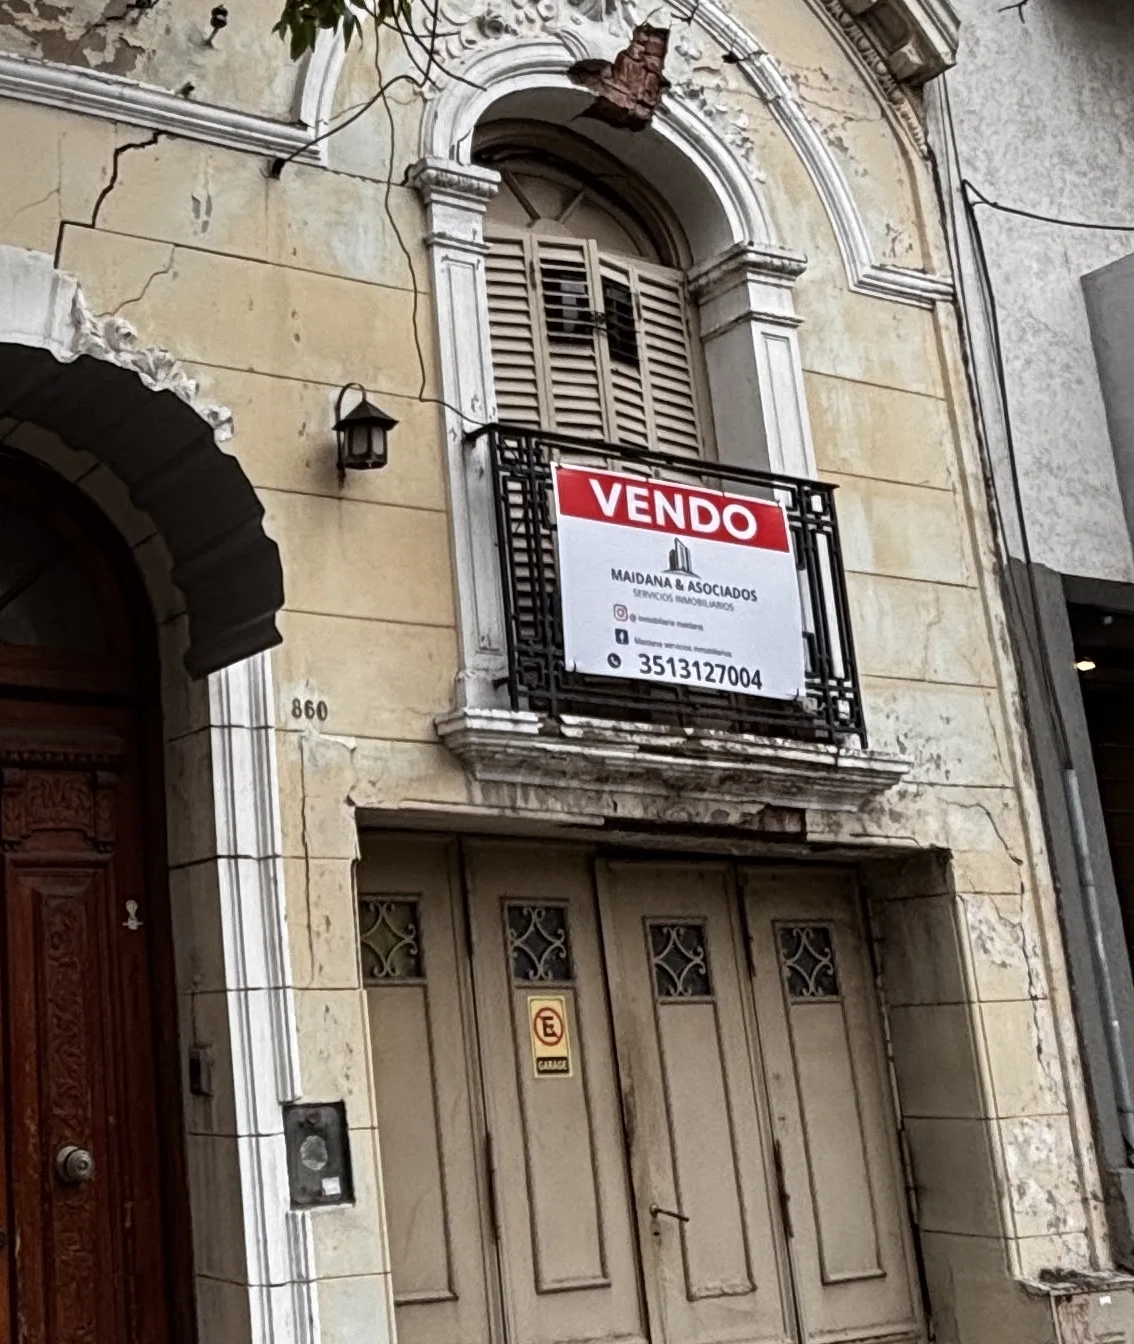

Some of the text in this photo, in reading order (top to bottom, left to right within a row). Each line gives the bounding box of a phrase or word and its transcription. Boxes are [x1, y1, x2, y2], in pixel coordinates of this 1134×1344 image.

[588, 478, 757, 540] VENDO
[611, 568, 758, 602] MAIDANA & ASOCIADOS
[633, 588, 734, 612] SERVICIOS INMOBILIARIOS
[638, 653, 763, 690] 3513127004
[291, 697, 328, 721] 860
[542, 1016, 556, 1037] E
[538, 1060, 567, 1071] GARAGE
